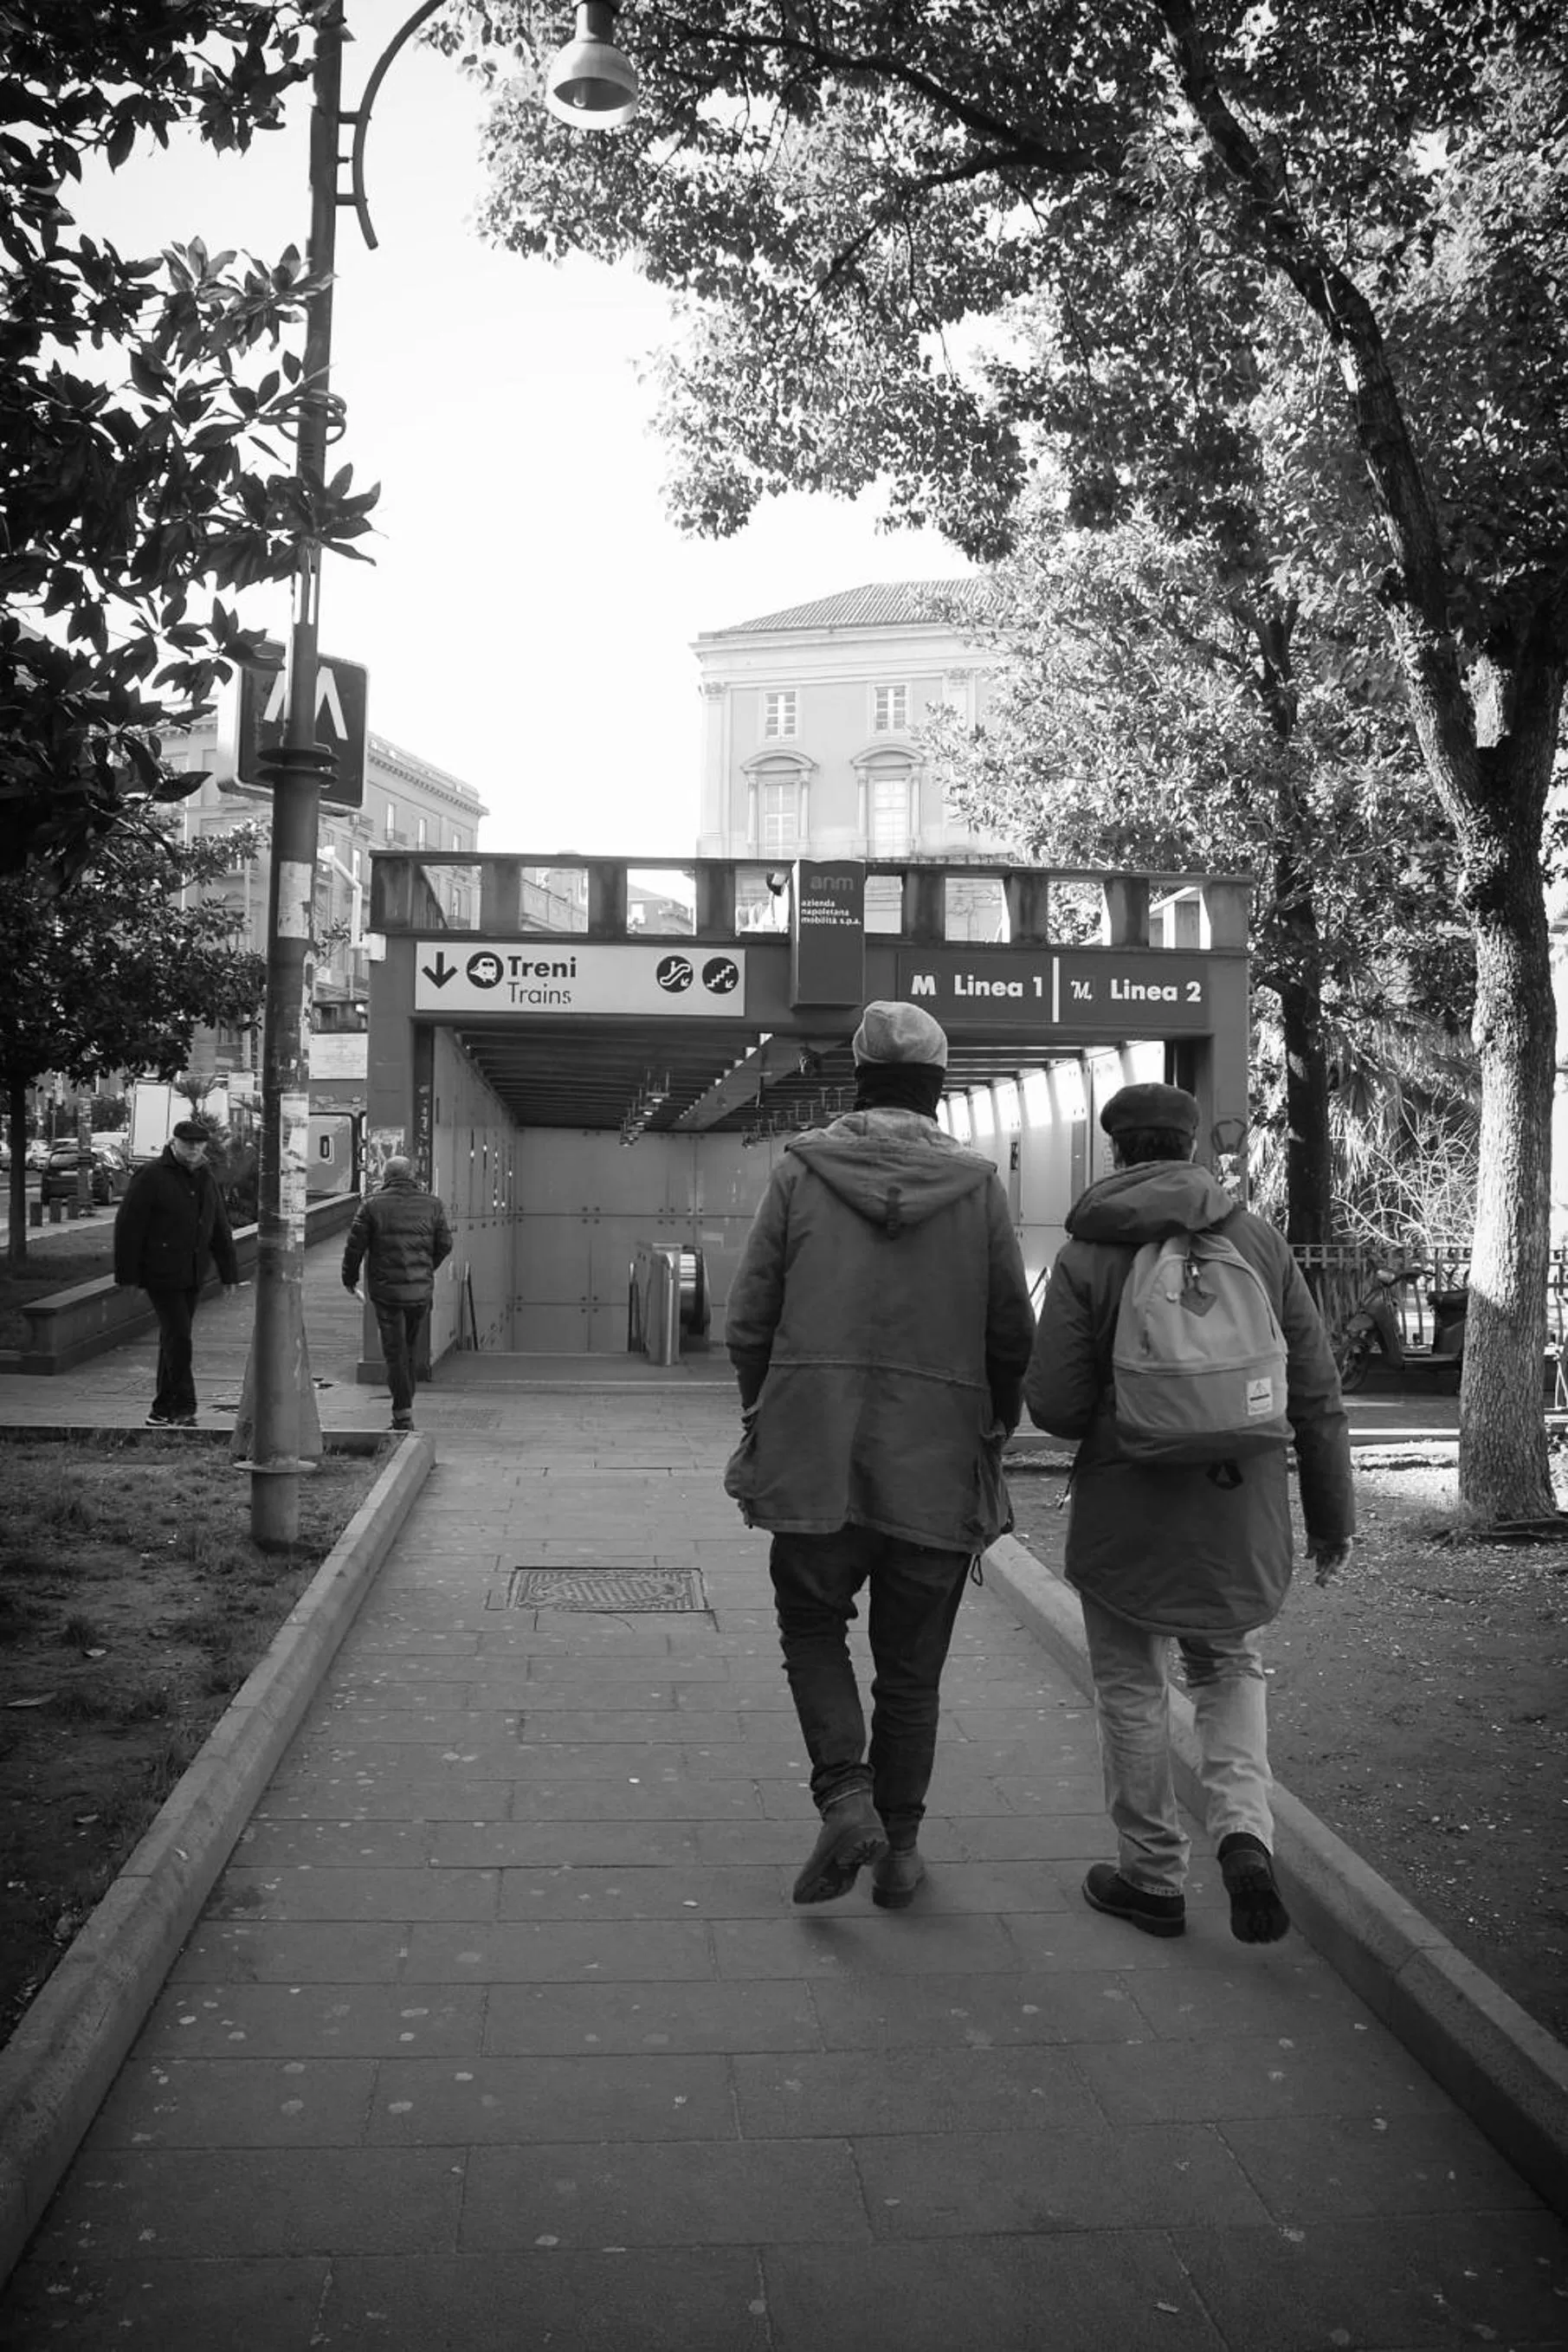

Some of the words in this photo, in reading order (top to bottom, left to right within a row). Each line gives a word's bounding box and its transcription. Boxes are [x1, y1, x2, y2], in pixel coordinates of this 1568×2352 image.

[810, 876, 854, 891] anm
[801, 899, 836, 908] azienda
[801, 908, 849, 917] napoletana
[507, 955, 577, 978] Treni
[507, 981, 571, 1005] Trains
[911, 974, 936, 996] M
[954, 974, 1023, 997] Linea
[1033, 976, 1042, 997] 1
[1111, 978, 1178, 1001] Linea
[1185, 980, 1202, 1002] 2
